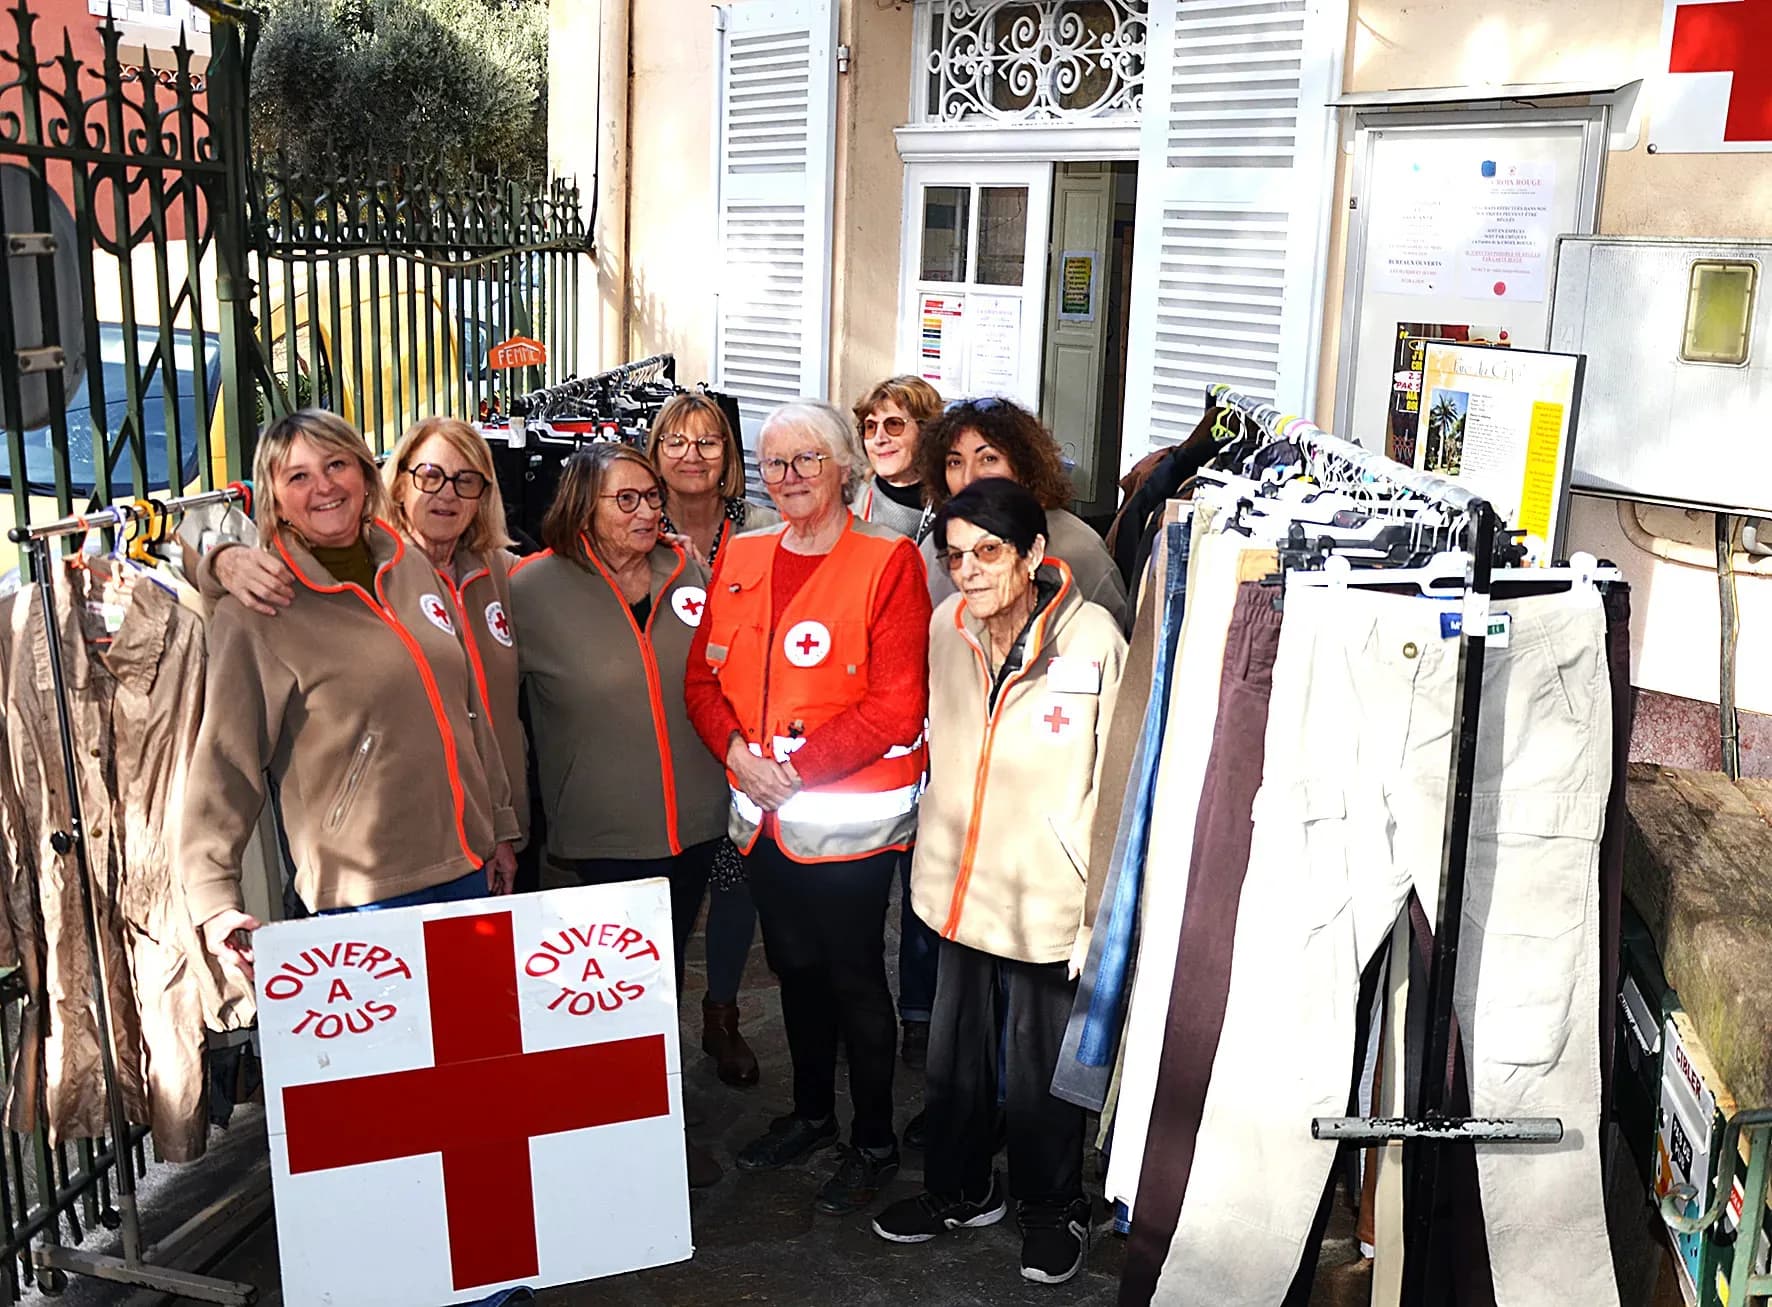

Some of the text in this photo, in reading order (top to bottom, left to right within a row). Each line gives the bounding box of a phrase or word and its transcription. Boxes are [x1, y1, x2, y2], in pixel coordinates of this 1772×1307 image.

[1516, 178, 1542, 186] ROUGE
[498, 347, 538, 365] FEMME
[524, 923, 660, 978] OUVERT
[264, 942, 412, 1001] OUVERT
[581, 958, 604, 982] A
[327, 978, 353, 1004] A
[547, 980, 645, 1016] TOUS
[291, 1000, 397, 1039] TOUS
